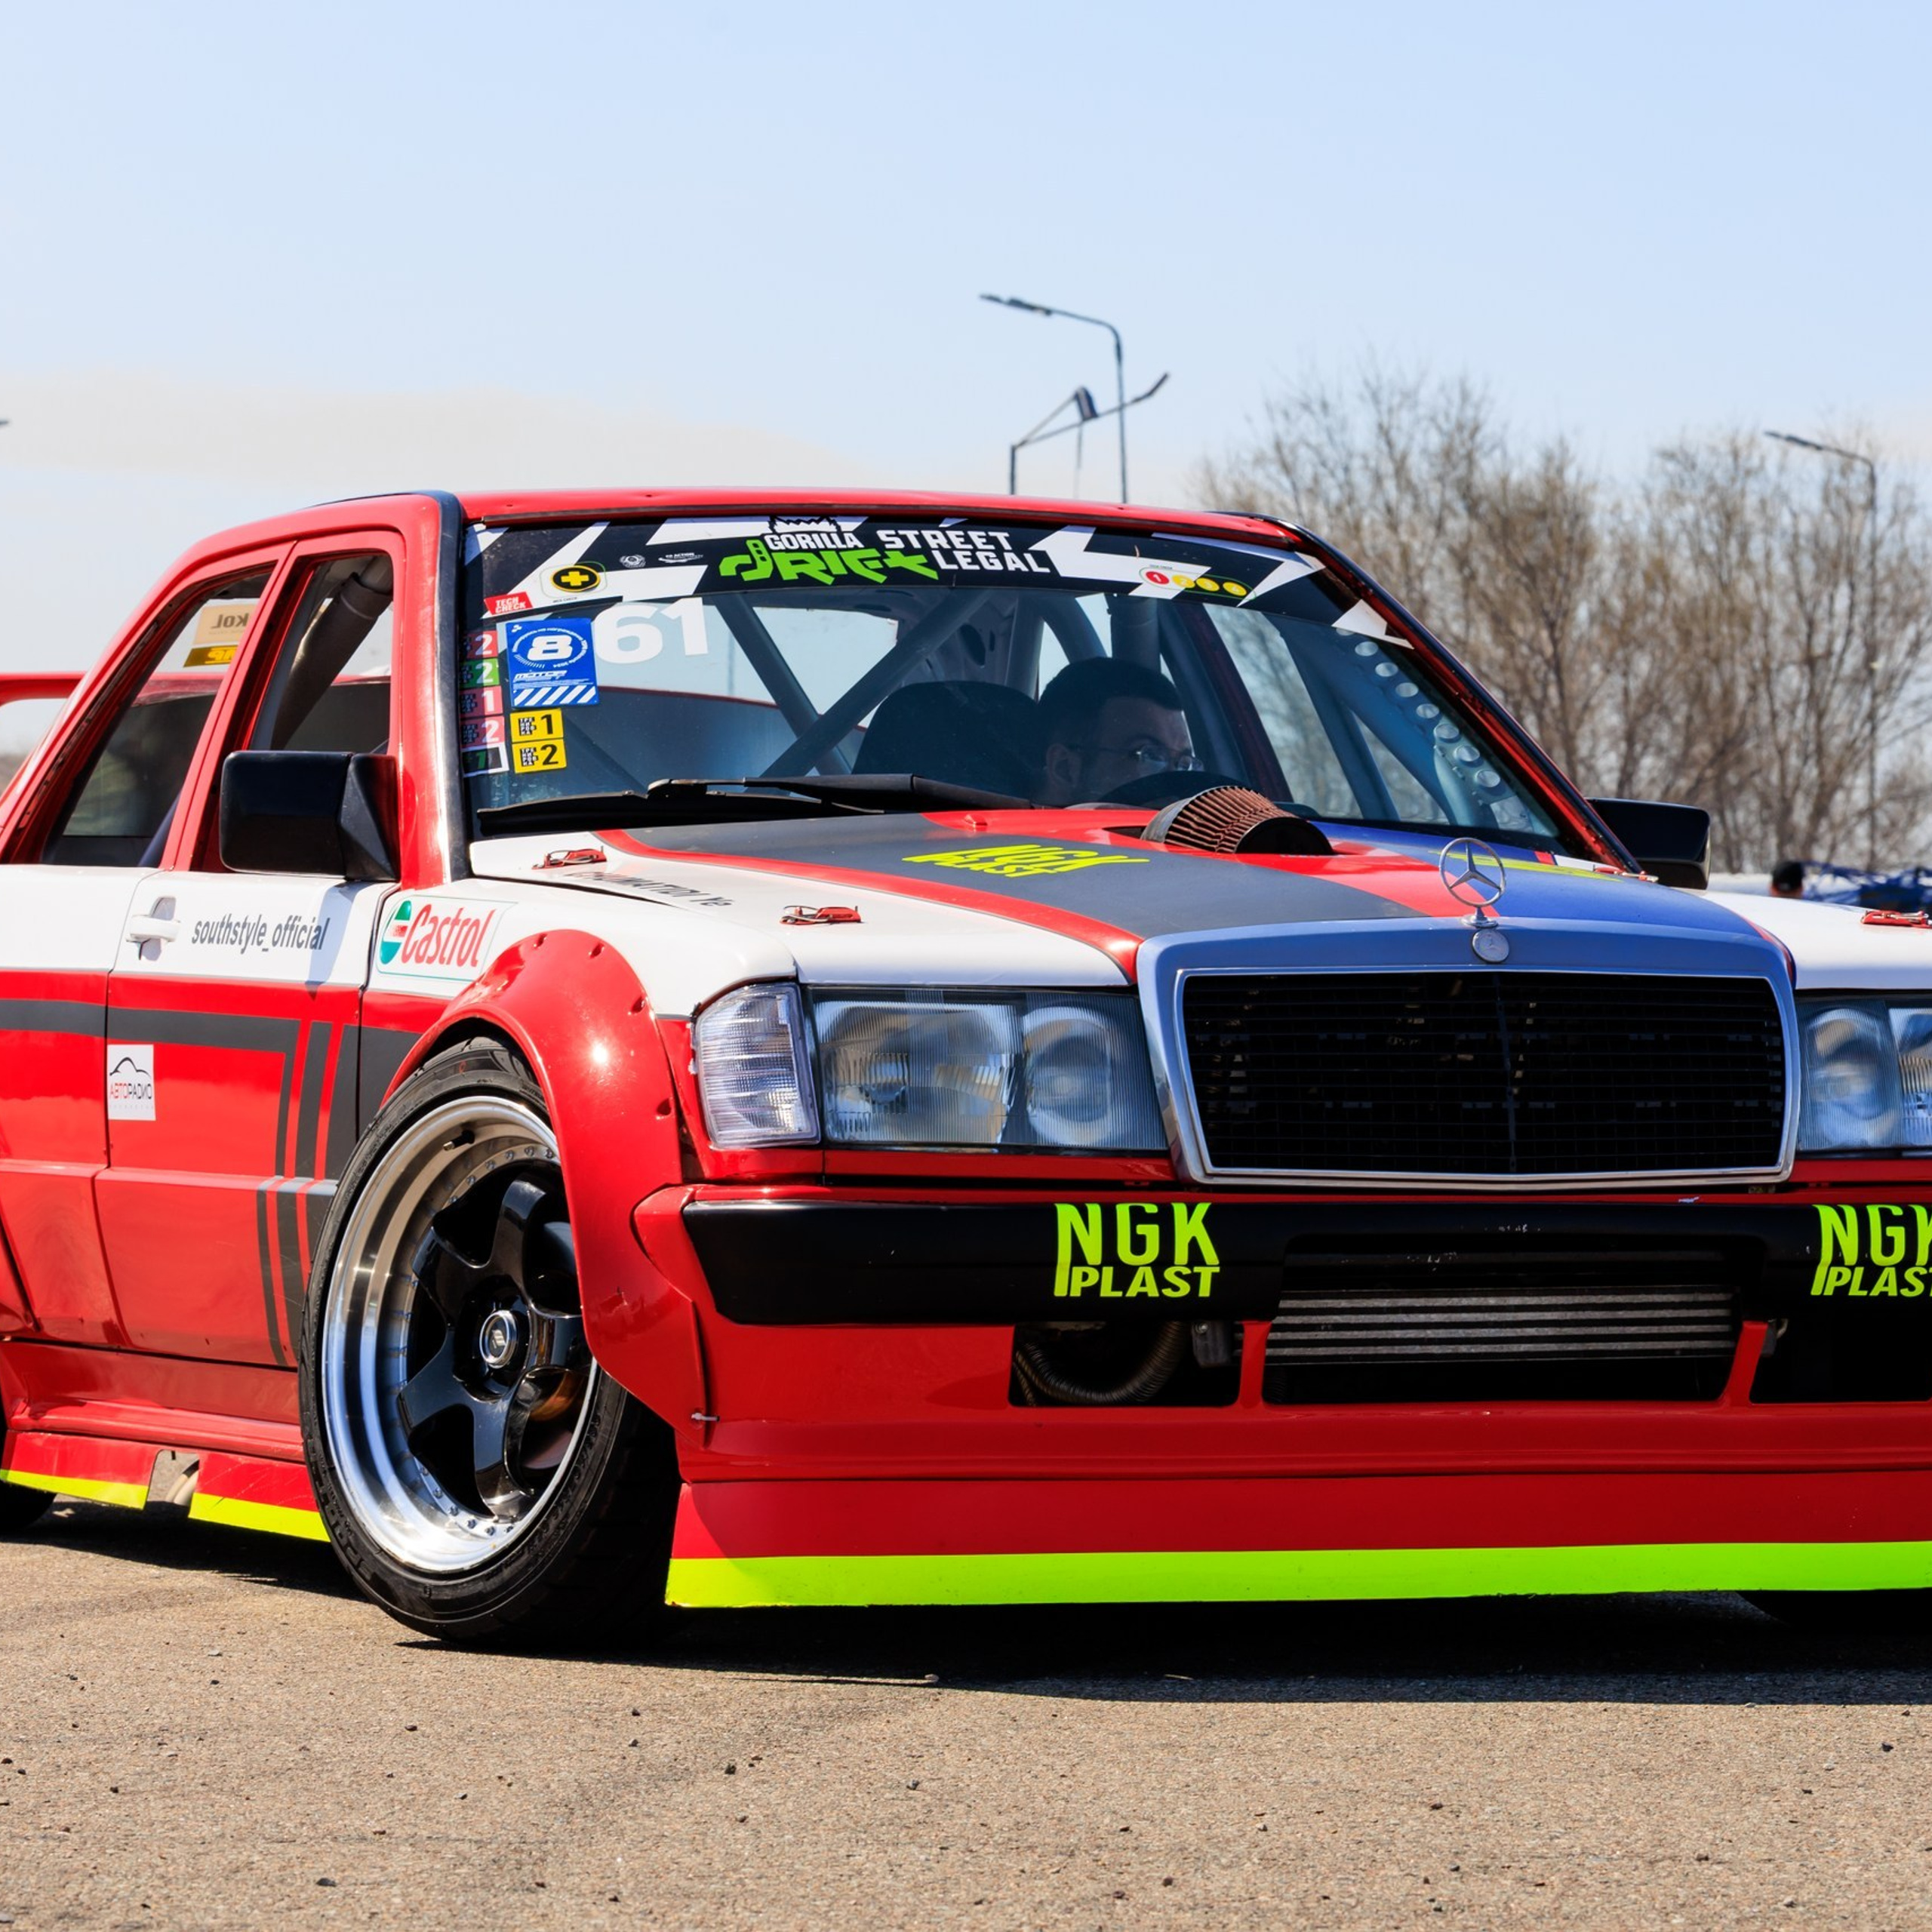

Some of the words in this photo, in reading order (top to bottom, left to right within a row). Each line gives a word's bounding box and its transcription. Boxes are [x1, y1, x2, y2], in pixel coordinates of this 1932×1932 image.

[764, 532, 864, 550] GORILLA
[876, 530, 1012, 551] STREET
[931, 549, 1050, 573] LEGAL
[494, 601, 527, 614] CHECK
[495, 596, 519, 607] TECH
[594, 597, 709, 663] 61
[475, 633, 493, 656] 2
[527, 634, 572, 661] 8
[475, 661, 494, 684] 2
[481, 719, 500, 743] 2
[540, 714, 554, 735] 1
[540, 743, 558, 765] 2
[192, 913, 331, 954] southstyle_official
[401, 904, 496, 968] Castrol
[109, 1082, 153, 1100] АВТОРАДИО
[1054, 1202, 1220, 1297] NGK
[1069, 1266, 1220, 1297] PLAST
[1823, 1266, 1932, 1297] PLAS
